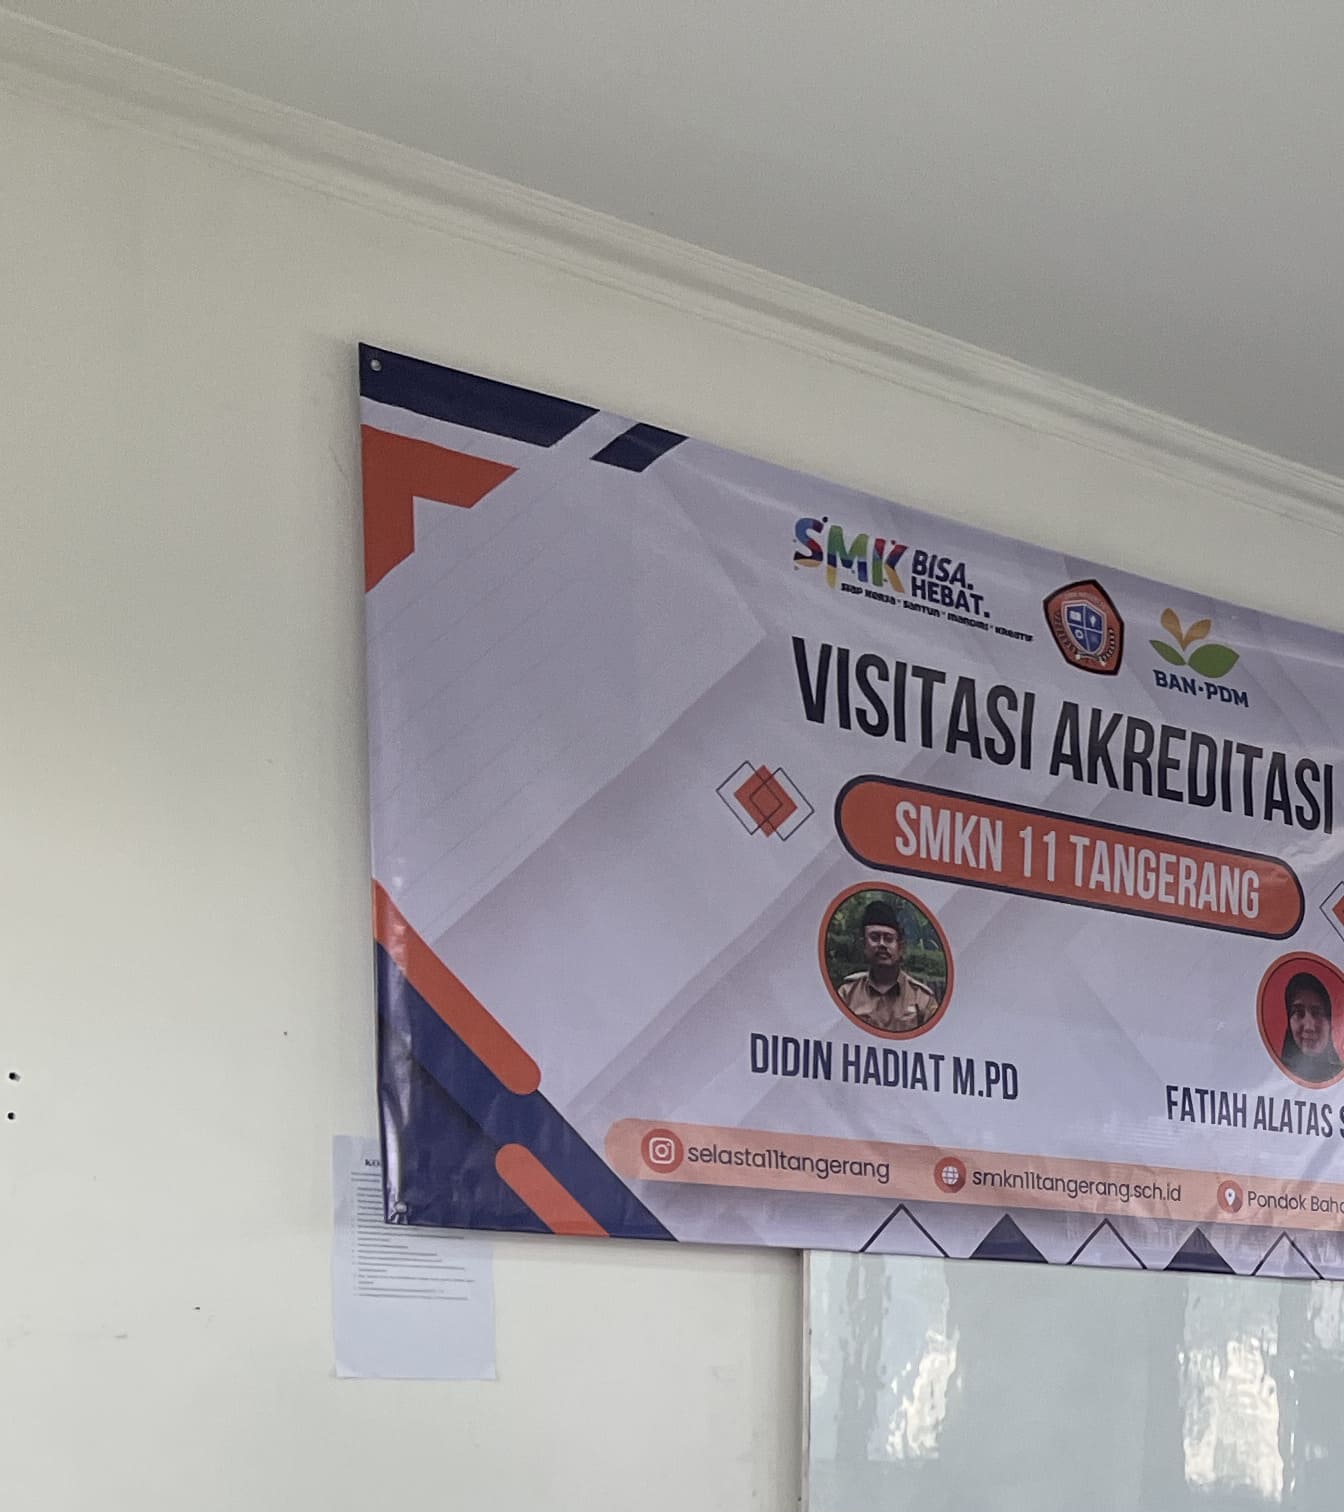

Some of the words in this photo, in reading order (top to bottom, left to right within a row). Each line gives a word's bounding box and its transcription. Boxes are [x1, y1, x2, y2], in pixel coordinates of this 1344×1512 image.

[793, 517, 909, 593] SMK
[912, 550, 974, 590] BISA.
[911, 576, 990, 618] HEBAT.
[791, 636, 1036, 769] VISITASI
[1049, 701, 1334, 835] AKREDITASI
[895, 801, 1003, 872] SMKN
[1018, 825, 1057, 882] 11
[1069, 834, 1260, 919] TANGERANG
[750, 1033, 832, 1081] DIDIN
[842, 1043, 945, 1092] HADIAT
[952, 1056, 1018, 1100] M.PD
[1166, 1085, 1247, 1128] FATIAH
[1253, 1095, 1333, 1138] ALATAS
[1247, 1191, 1308, 1211] Pondok
